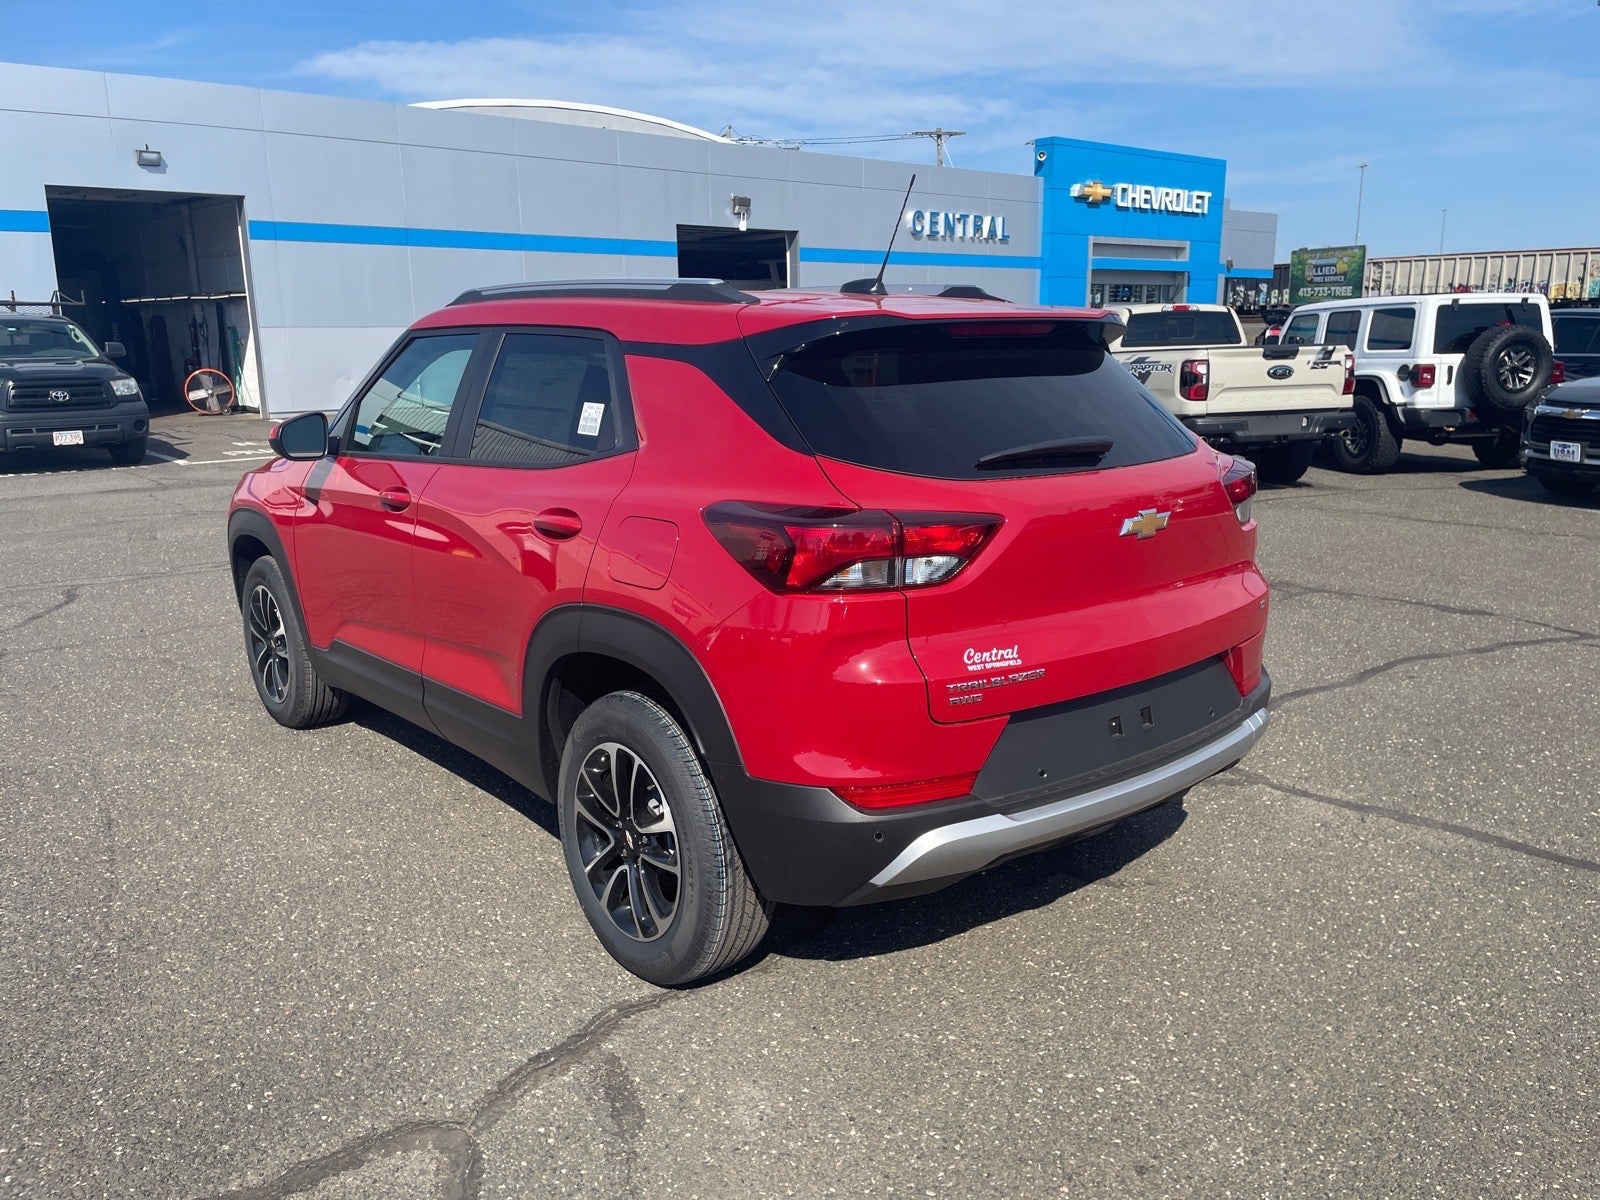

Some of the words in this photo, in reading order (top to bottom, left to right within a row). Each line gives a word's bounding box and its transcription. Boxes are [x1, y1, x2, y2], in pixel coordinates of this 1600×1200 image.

[1115, 183, 1212, 214] CHEVROLET
[908, 210, 1010, 241] CENTRAL
[1298, 286, 1352, 297] 413-733-TREE
[1130, 363, 1172, 374] RAPTOR
[963, 645, 1018, 664] Central
[985, 659, 1022, 669] SPRINGFIELD
[946, 668, 1046, 693] TRAILBLAZER
